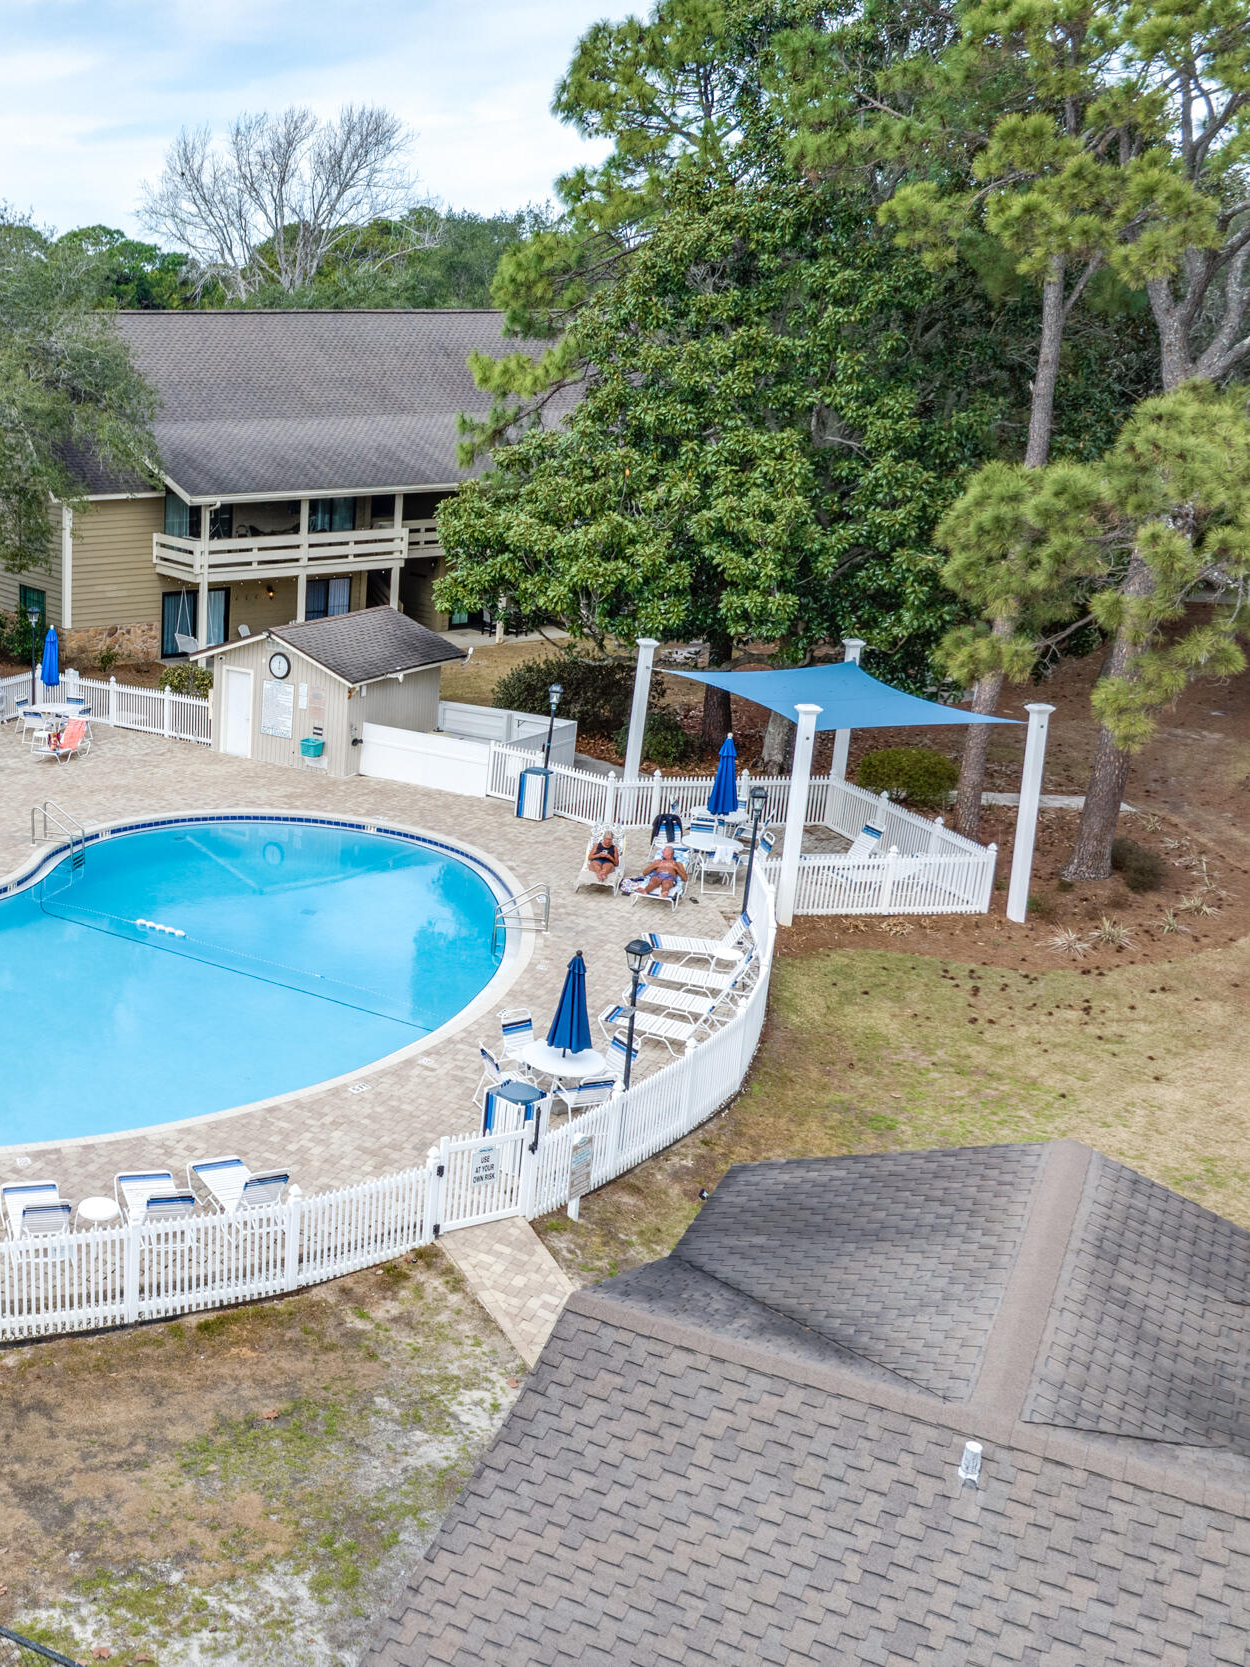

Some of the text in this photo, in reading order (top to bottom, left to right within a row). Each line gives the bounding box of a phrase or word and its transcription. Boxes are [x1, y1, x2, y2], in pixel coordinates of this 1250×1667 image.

[481, 1155, 491, 1164] USE
[482, 1163, 495, 1172] YOUR
[473, 1172, 495, 1183] OWN RISK
